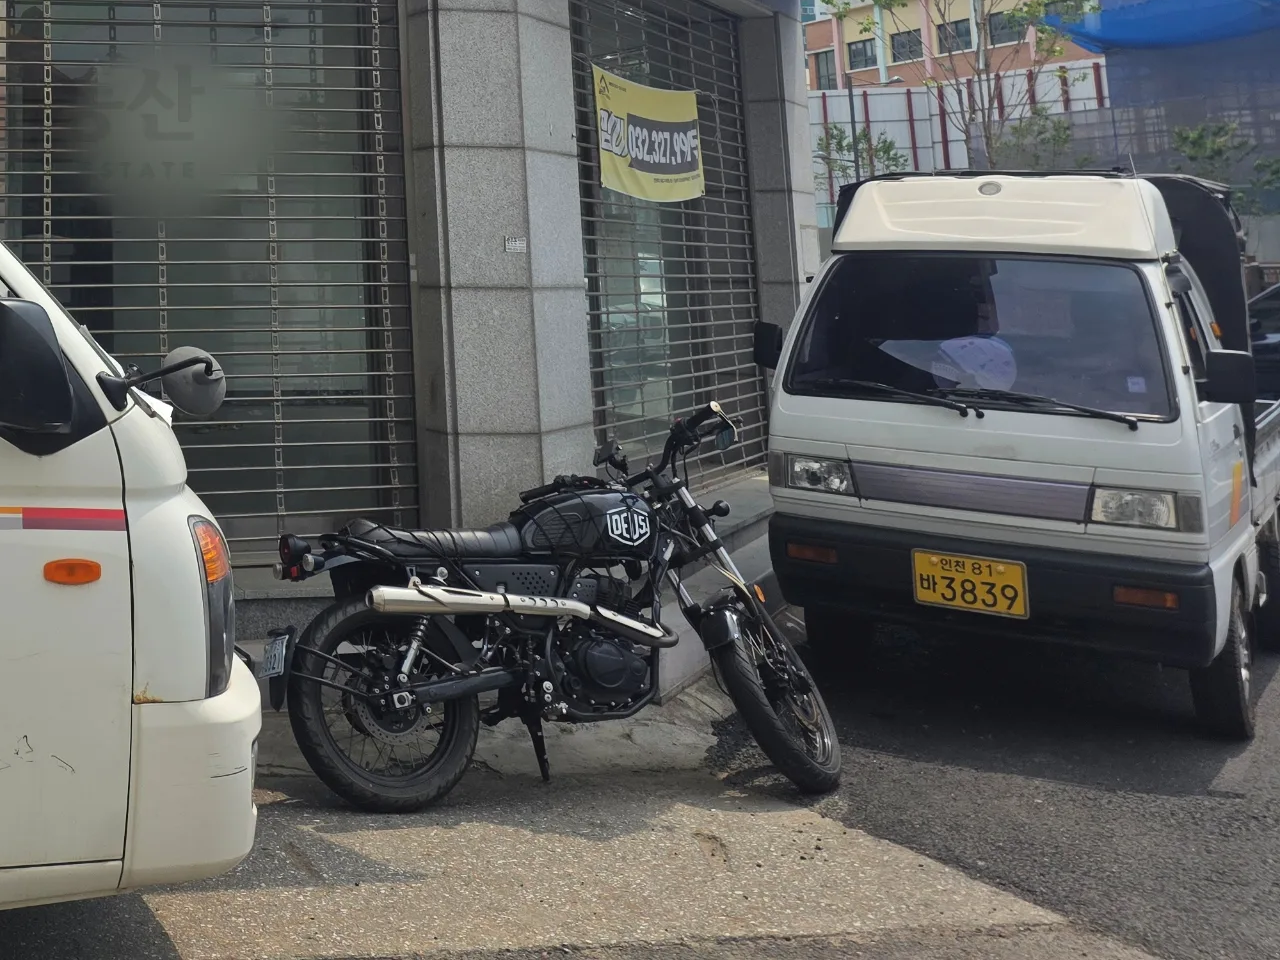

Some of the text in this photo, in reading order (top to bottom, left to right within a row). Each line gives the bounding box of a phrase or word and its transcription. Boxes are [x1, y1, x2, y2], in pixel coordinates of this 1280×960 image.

[611, 512, 647, 540] DEUS
[939, 557, 993, 577] 인천 81
